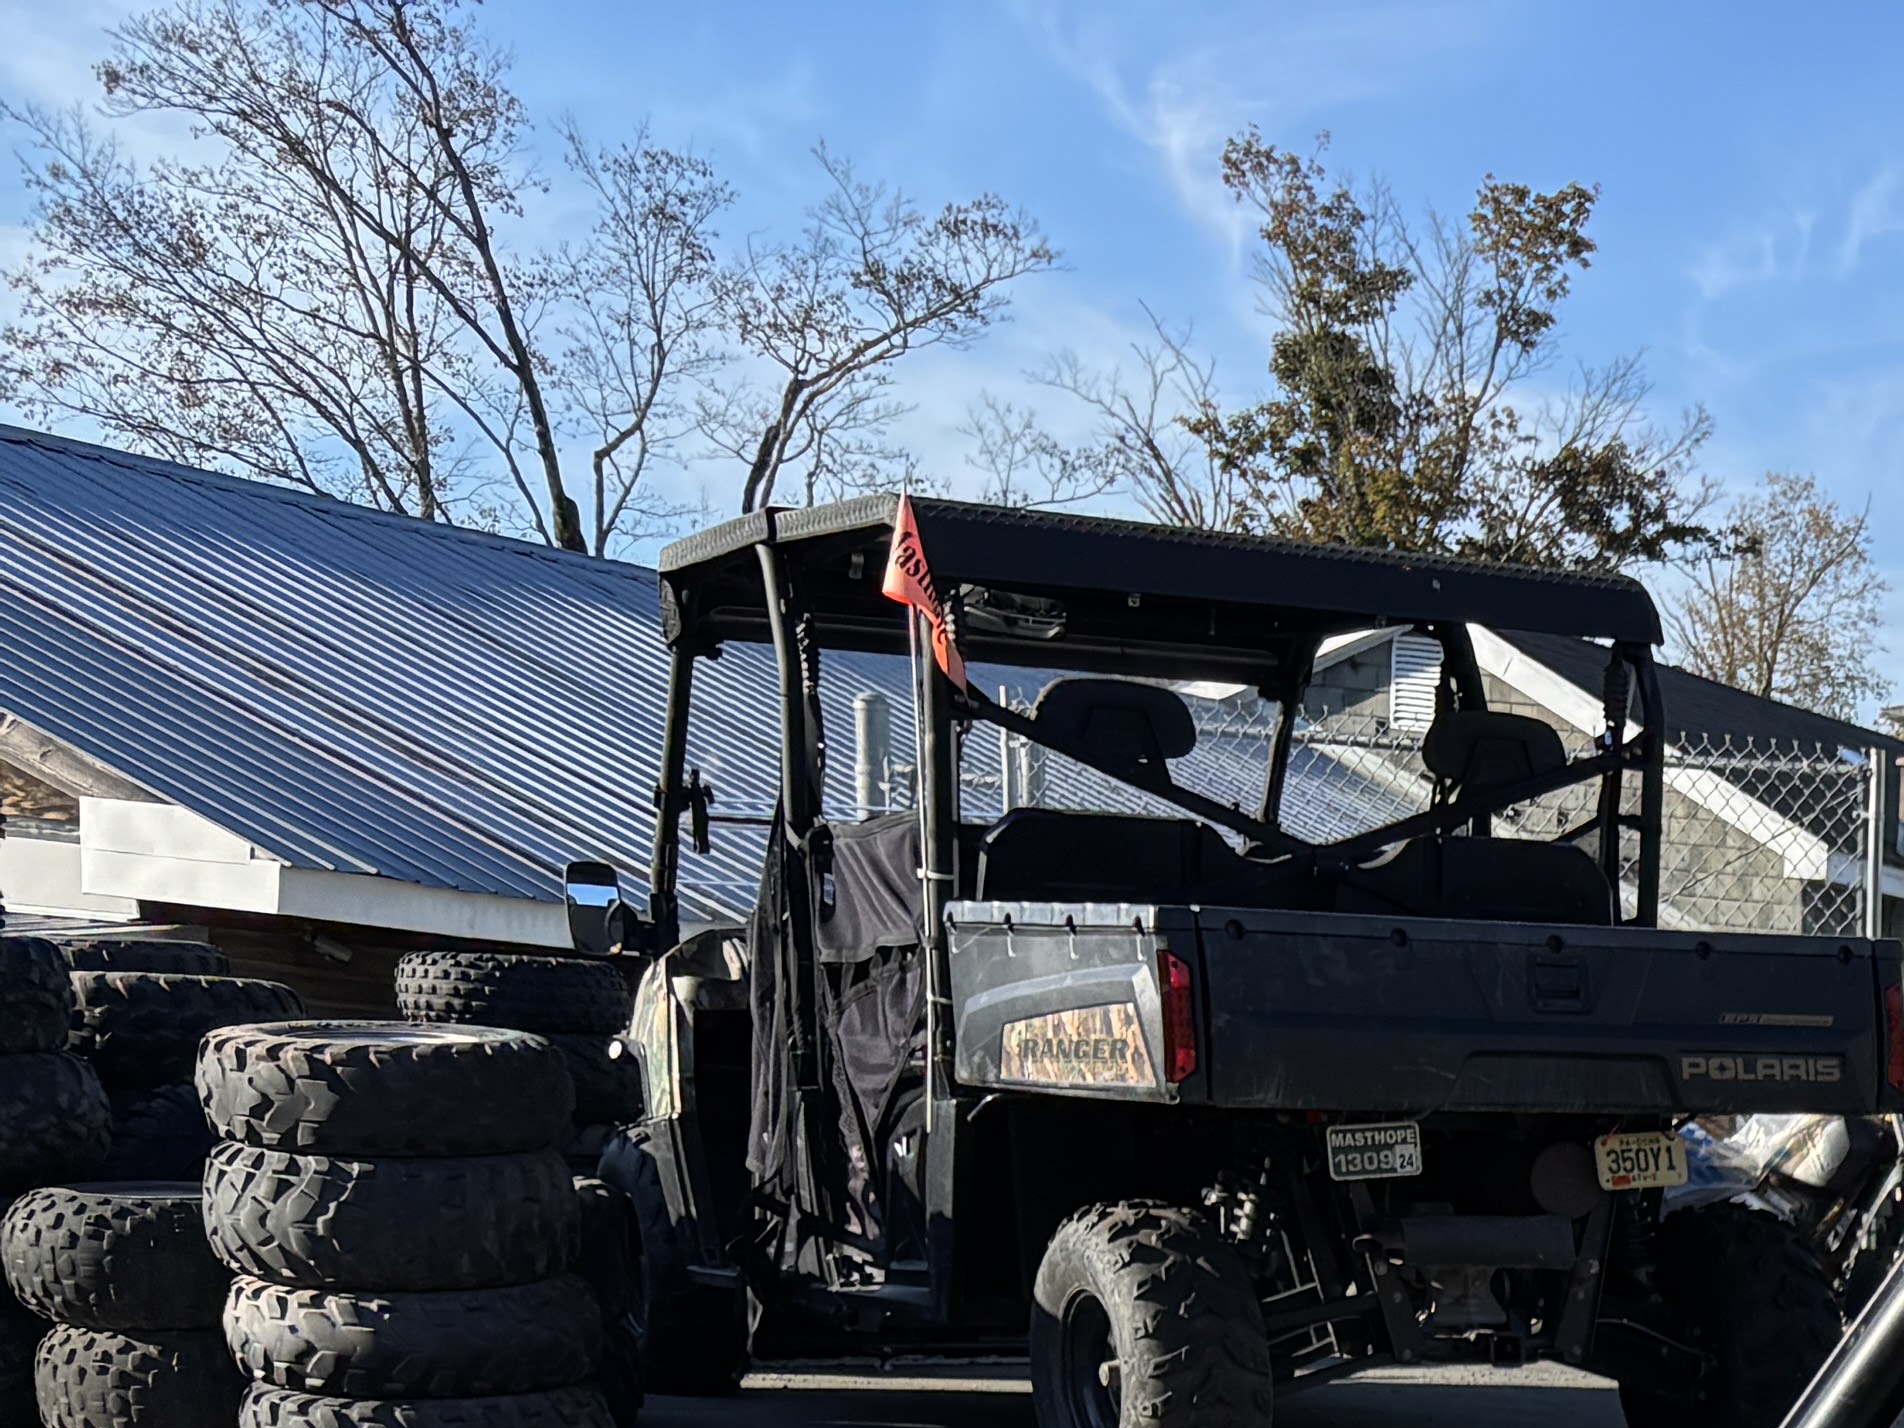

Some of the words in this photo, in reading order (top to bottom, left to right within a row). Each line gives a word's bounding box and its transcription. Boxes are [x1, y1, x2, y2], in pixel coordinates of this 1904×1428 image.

[1020, 1037, 1130, 1063] RANGER
[1681, 1056, 1842, 1083] POLARIS
[1331, 1129, 1416, 1148] MASTHOPE
[1334, 1150, 1394, 1173] 1309
[1399, 1153, 1414, 1170] 24
[1606, 1145, 1677, 1175] 350Y1
